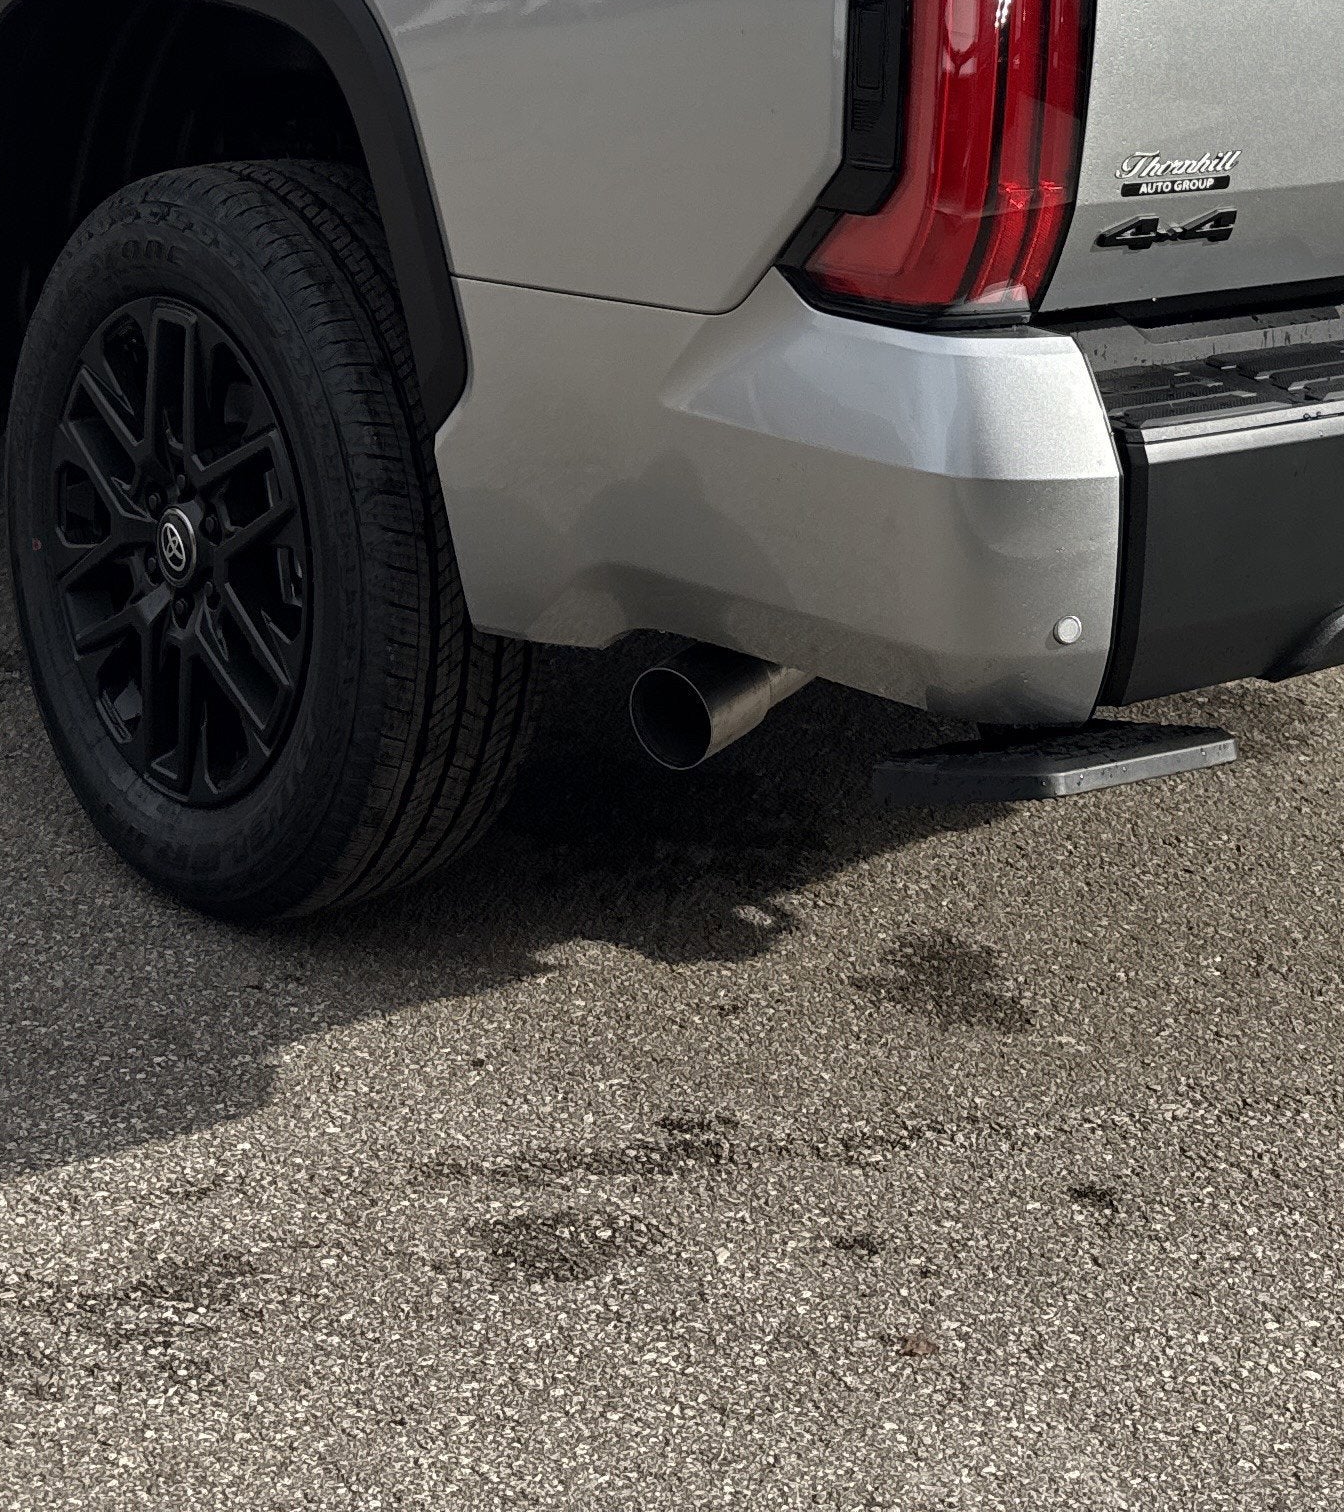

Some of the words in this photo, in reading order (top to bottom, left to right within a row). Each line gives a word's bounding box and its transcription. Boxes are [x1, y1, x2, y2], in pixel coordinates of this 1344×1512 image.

[1115, 149, 1242, 179] Thornhill
[1138, 182, 1172, 195] AUTO
[1173, 177, 1216, 192] GROUP
